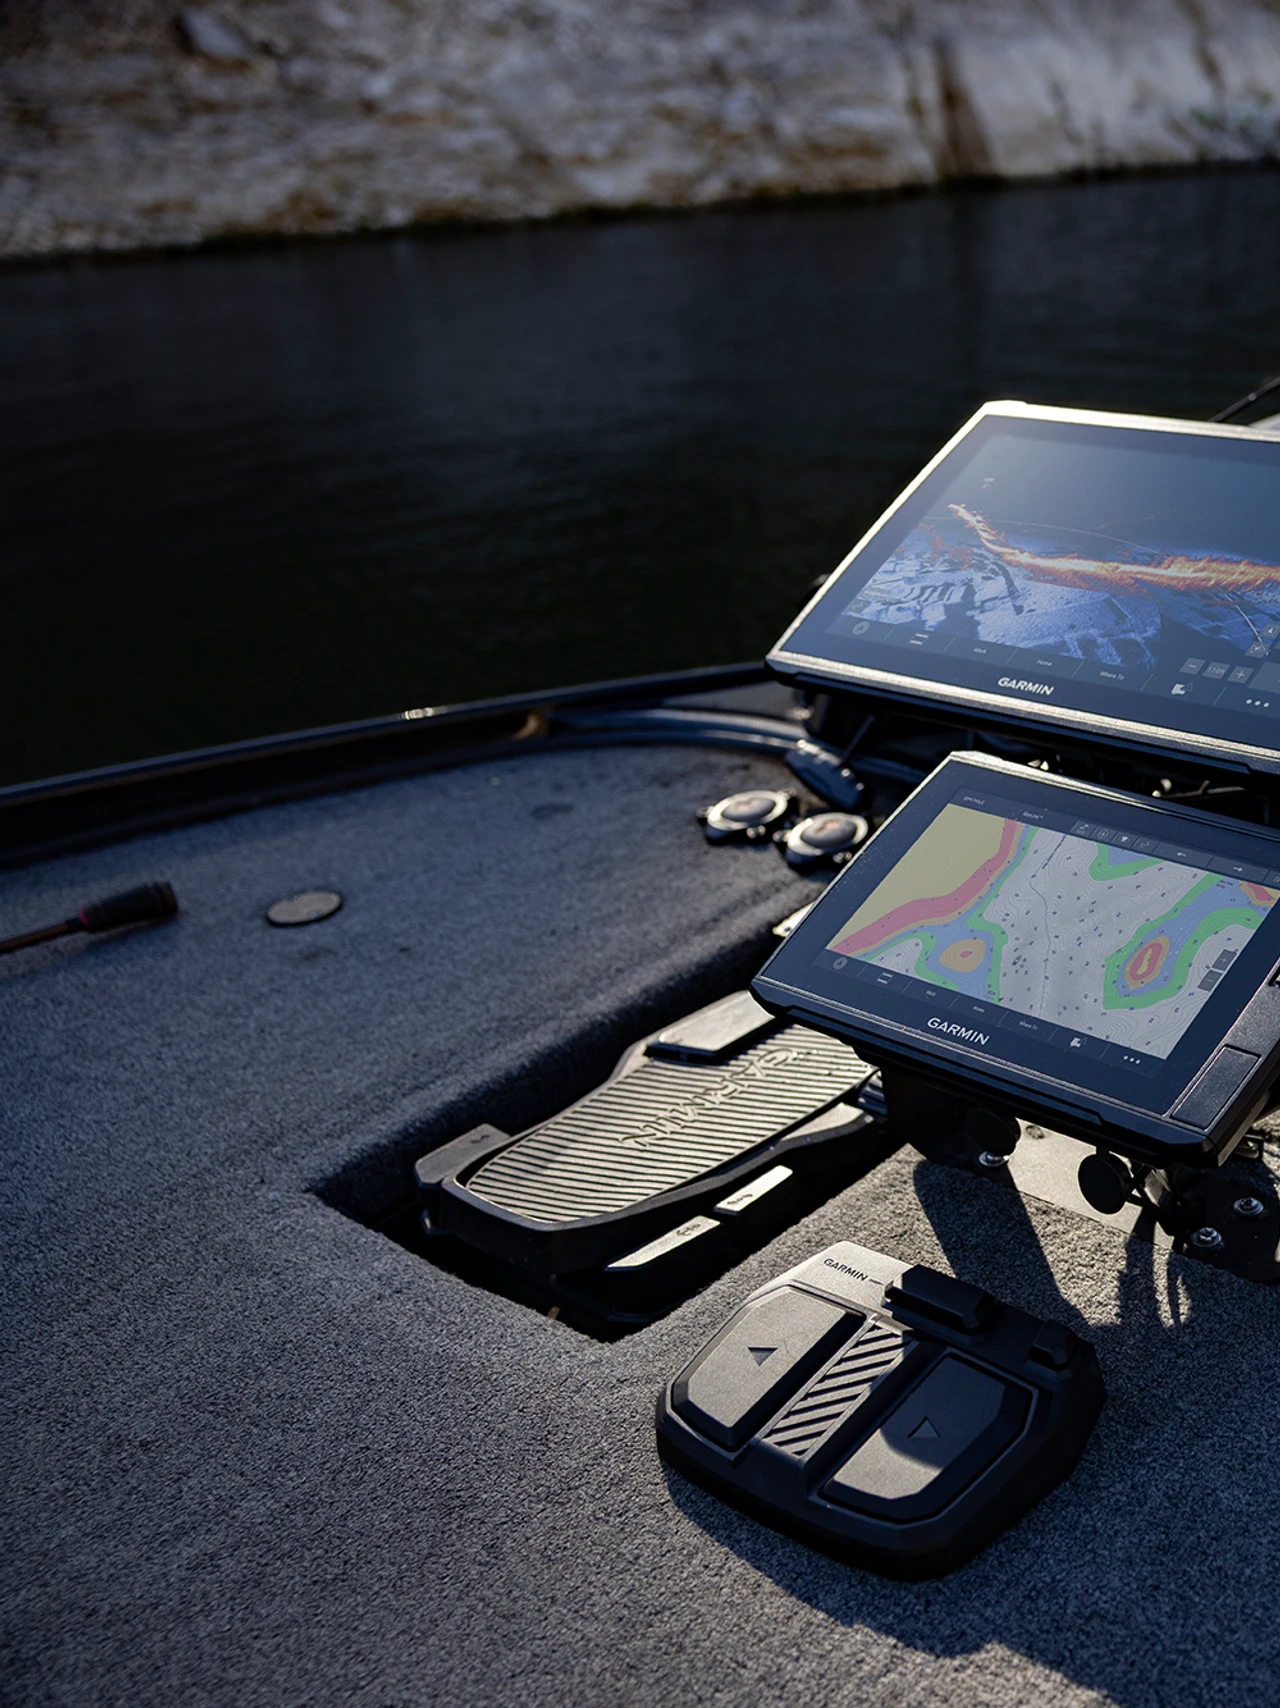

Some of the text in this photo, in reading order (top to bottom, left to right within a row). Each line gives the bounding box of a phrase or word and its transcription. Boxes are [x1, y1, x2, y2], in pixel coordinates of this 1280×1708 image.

[998, 677, 1054, 696] GARMIN
[927, 1017, 989, 1045] GARMIN
[619, 1048, 795, 1149] GARMIN
[824, 1258, 868, 1281] GARMIN
